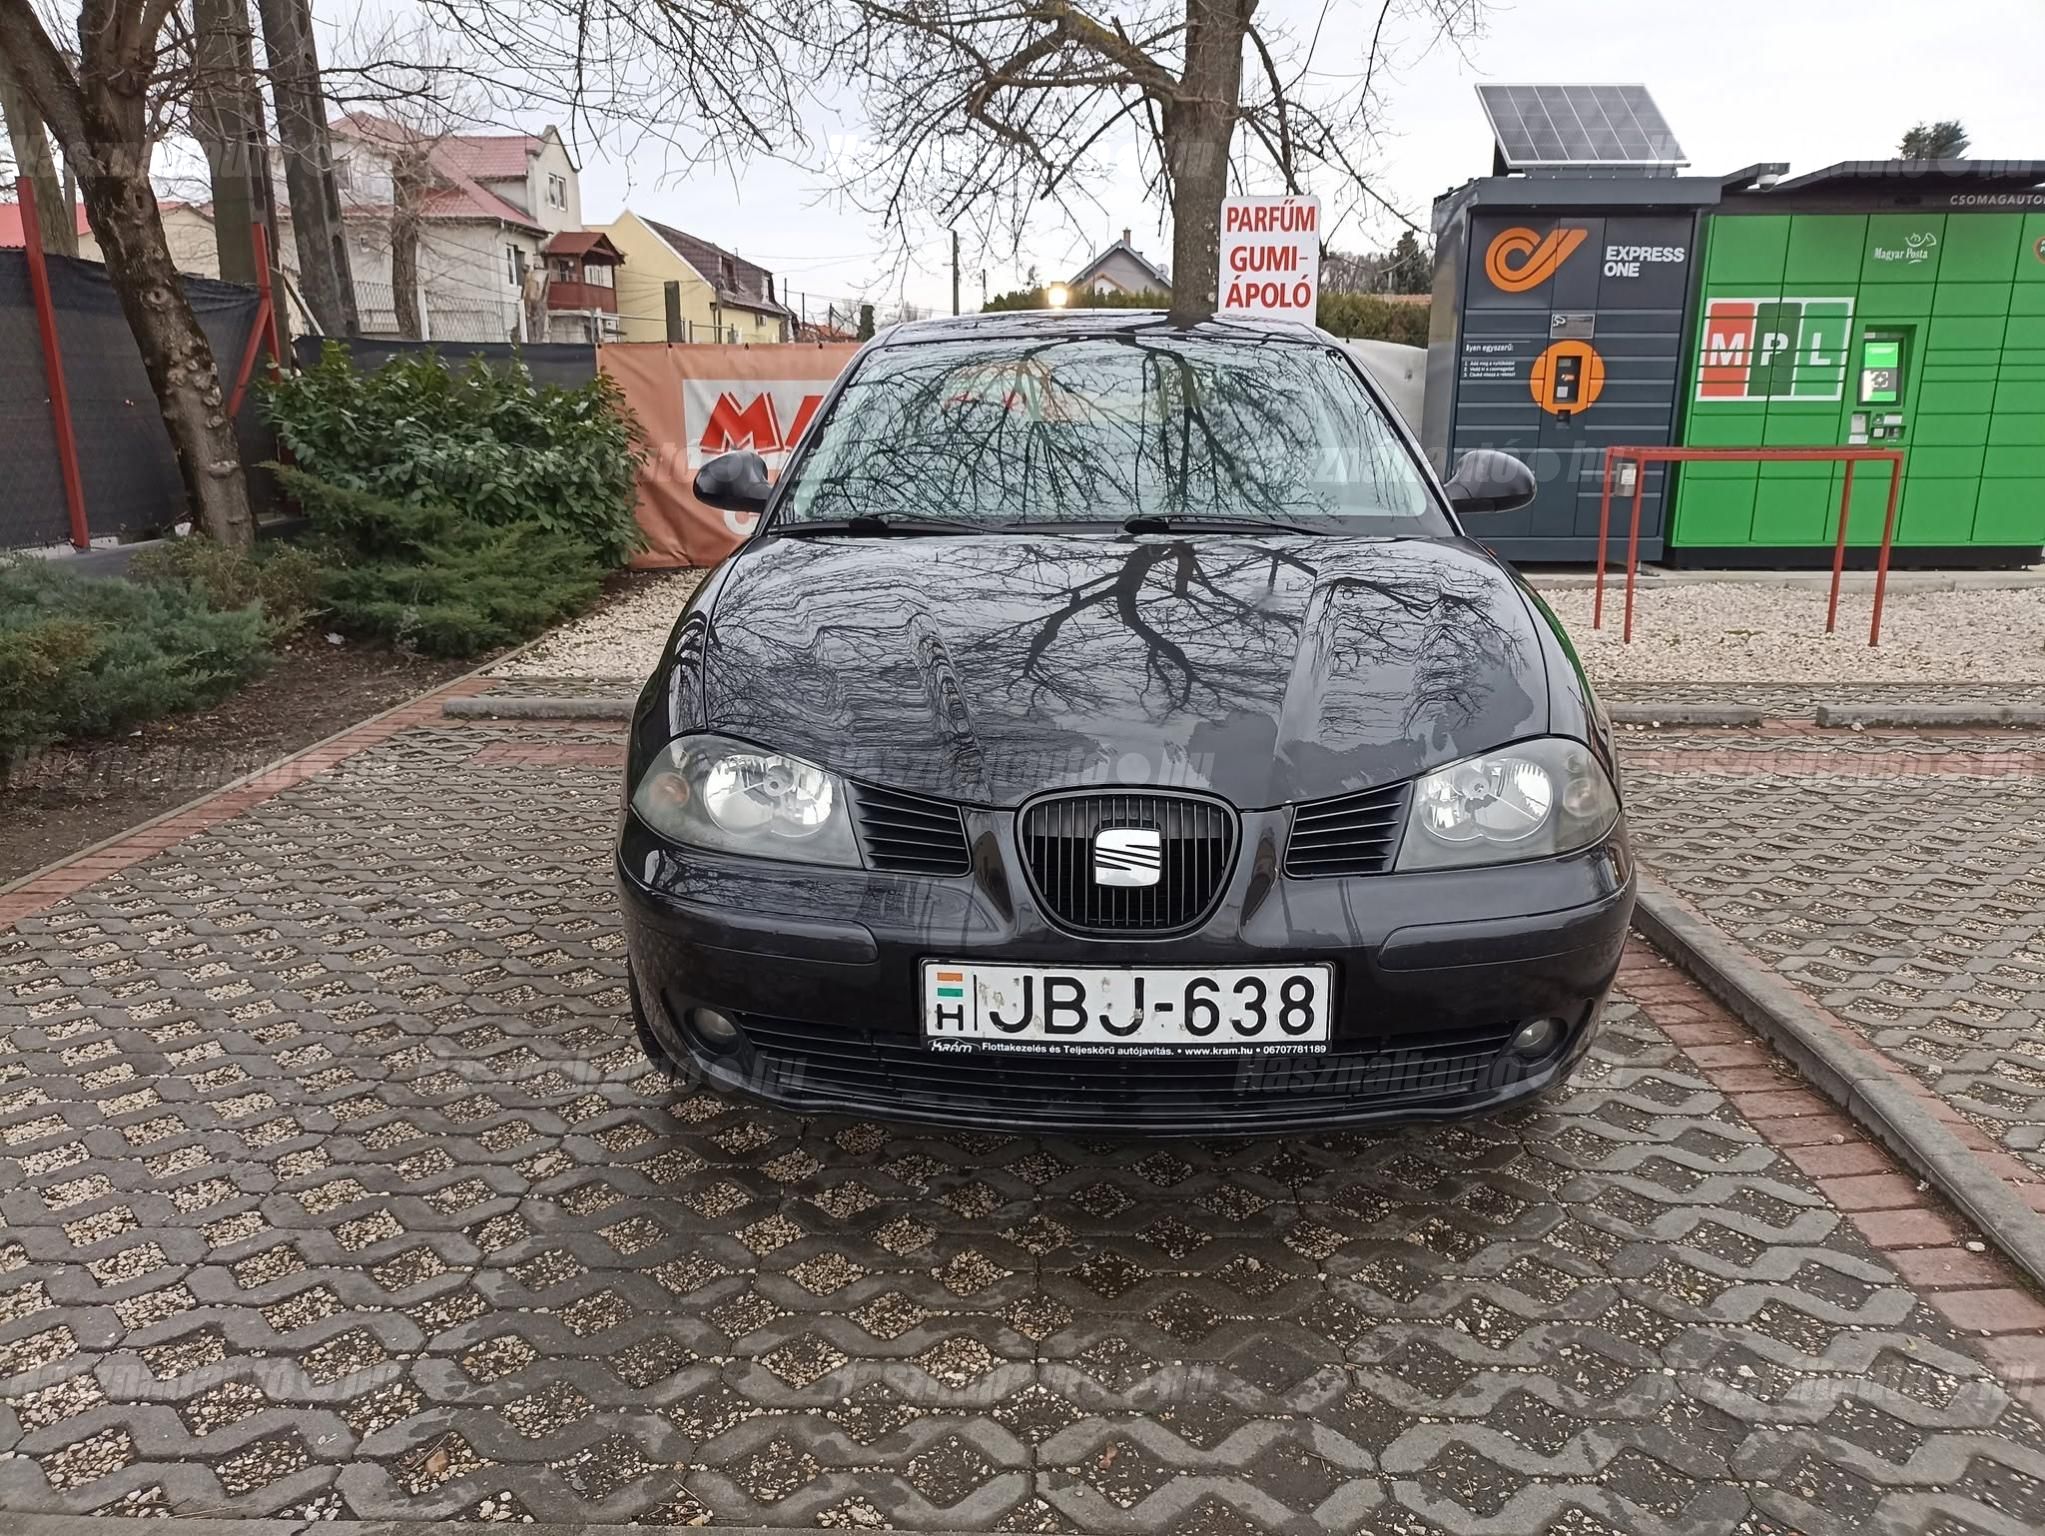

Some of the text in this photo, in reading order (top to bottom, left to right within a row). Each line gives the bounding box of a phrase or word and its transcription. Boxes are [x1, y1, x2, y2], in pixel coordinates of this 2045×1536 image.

[1226, 199, 1316, 232] PARFŰM
[1229, 245, 1309, 272] GUMI-
[1606, 246, 1684, 262] EXPRESS
[1874, 247, 1928, 261] Magyar Posta
[1604, 262, 1640, 277] ONE
[1224, 274, 1312, 308] ÁPOLÓ
[1708, 332, 1832, 366] MPL
[937, 975, 1315, 1036] H JBJ-638
[982, 1042, 1047, 1053] Flottakezelés
[1049, 1045, 1061, 1053] és
[1118, 1047, 1174, 1056] autójavítás.
[1185, 1046, 1253, 1056] www.kram.hu
[1263, 1045, 1327, 1054] 06707781189
